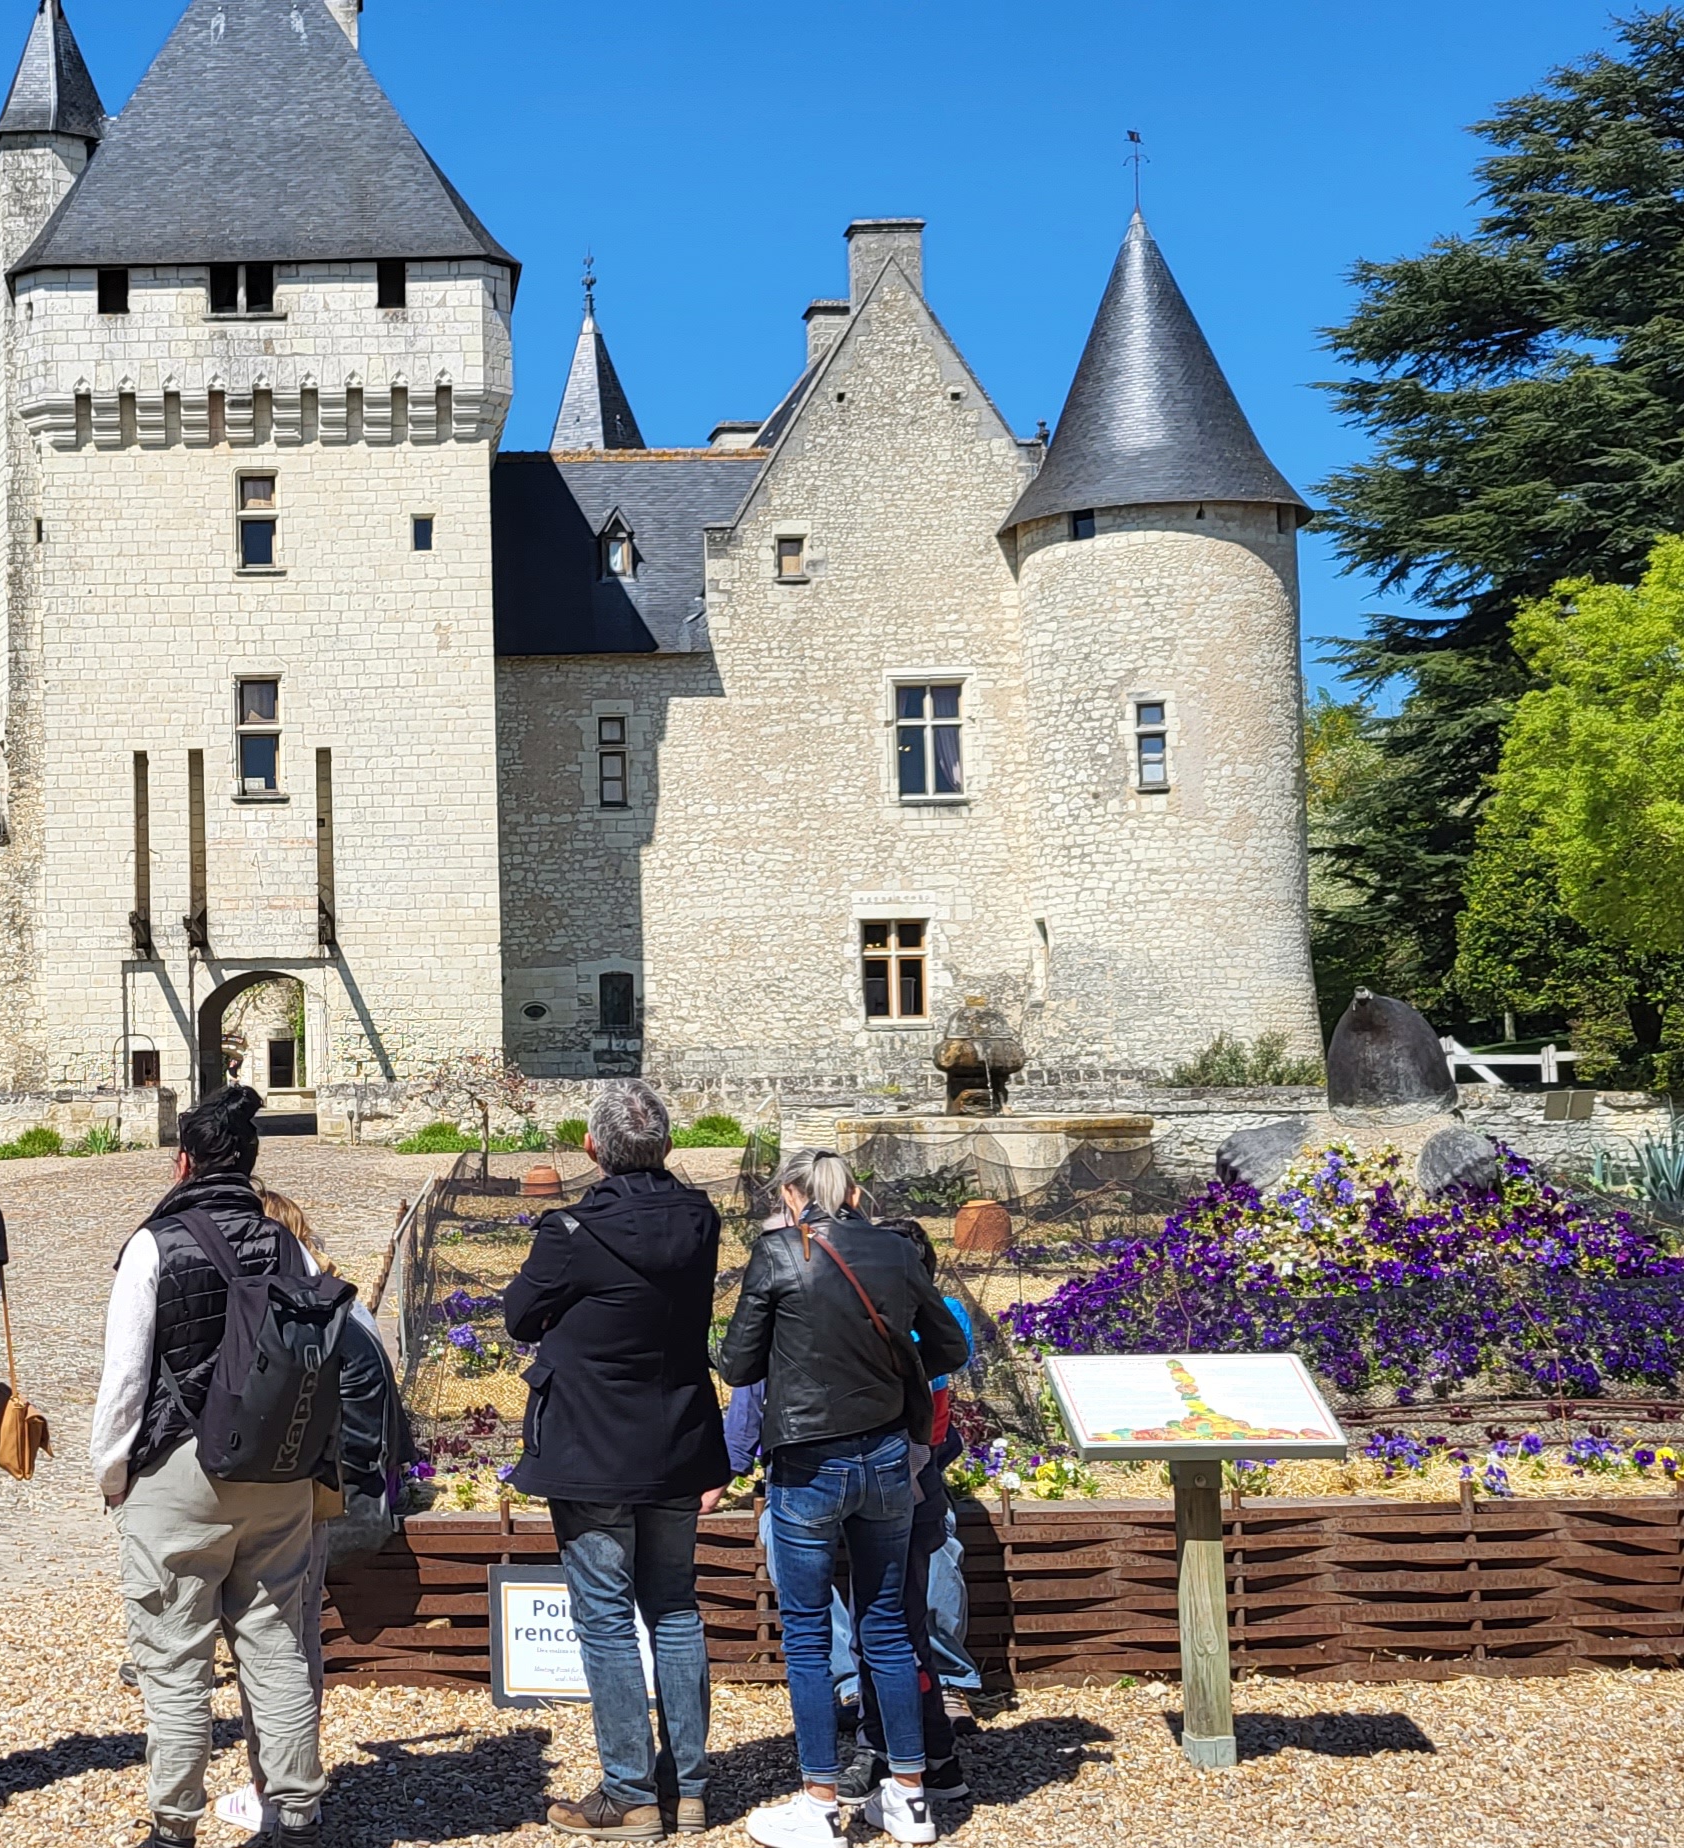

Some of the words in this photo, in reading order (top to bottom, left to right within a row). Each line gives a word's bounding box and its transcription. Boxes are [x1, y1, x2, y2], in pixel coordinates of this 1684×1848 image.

[271, 1344, 322, 1472] Kappa
[533, 1599, 572, 1618] Poi
[515, 1627, 579, 1643] renco
